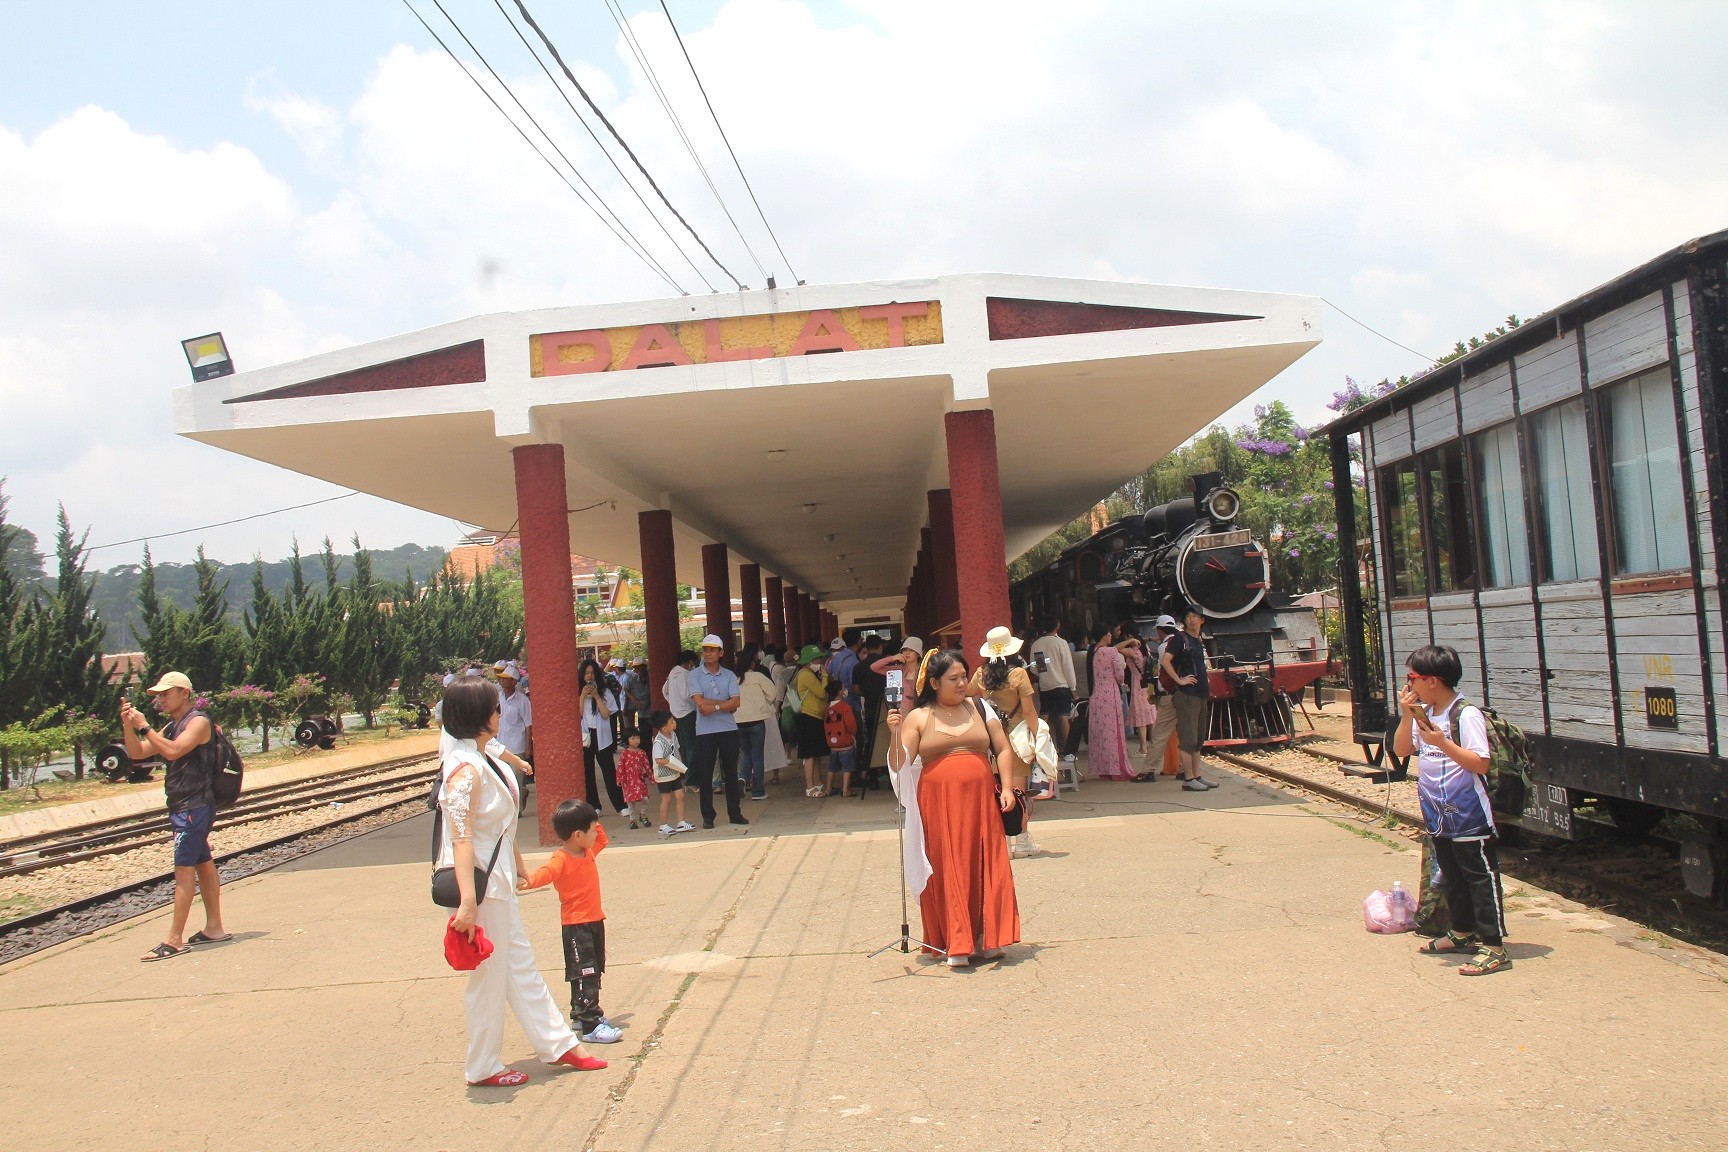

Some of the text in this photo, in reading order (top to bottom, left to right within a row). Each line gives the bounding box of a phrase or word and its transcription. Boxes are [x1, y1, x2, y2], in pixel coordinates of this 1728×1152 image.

[541, 302, 928, 377] DALAT
[1642, 655, 1675, 685] VNR
[1648, 697, 1675, 717] 1080
